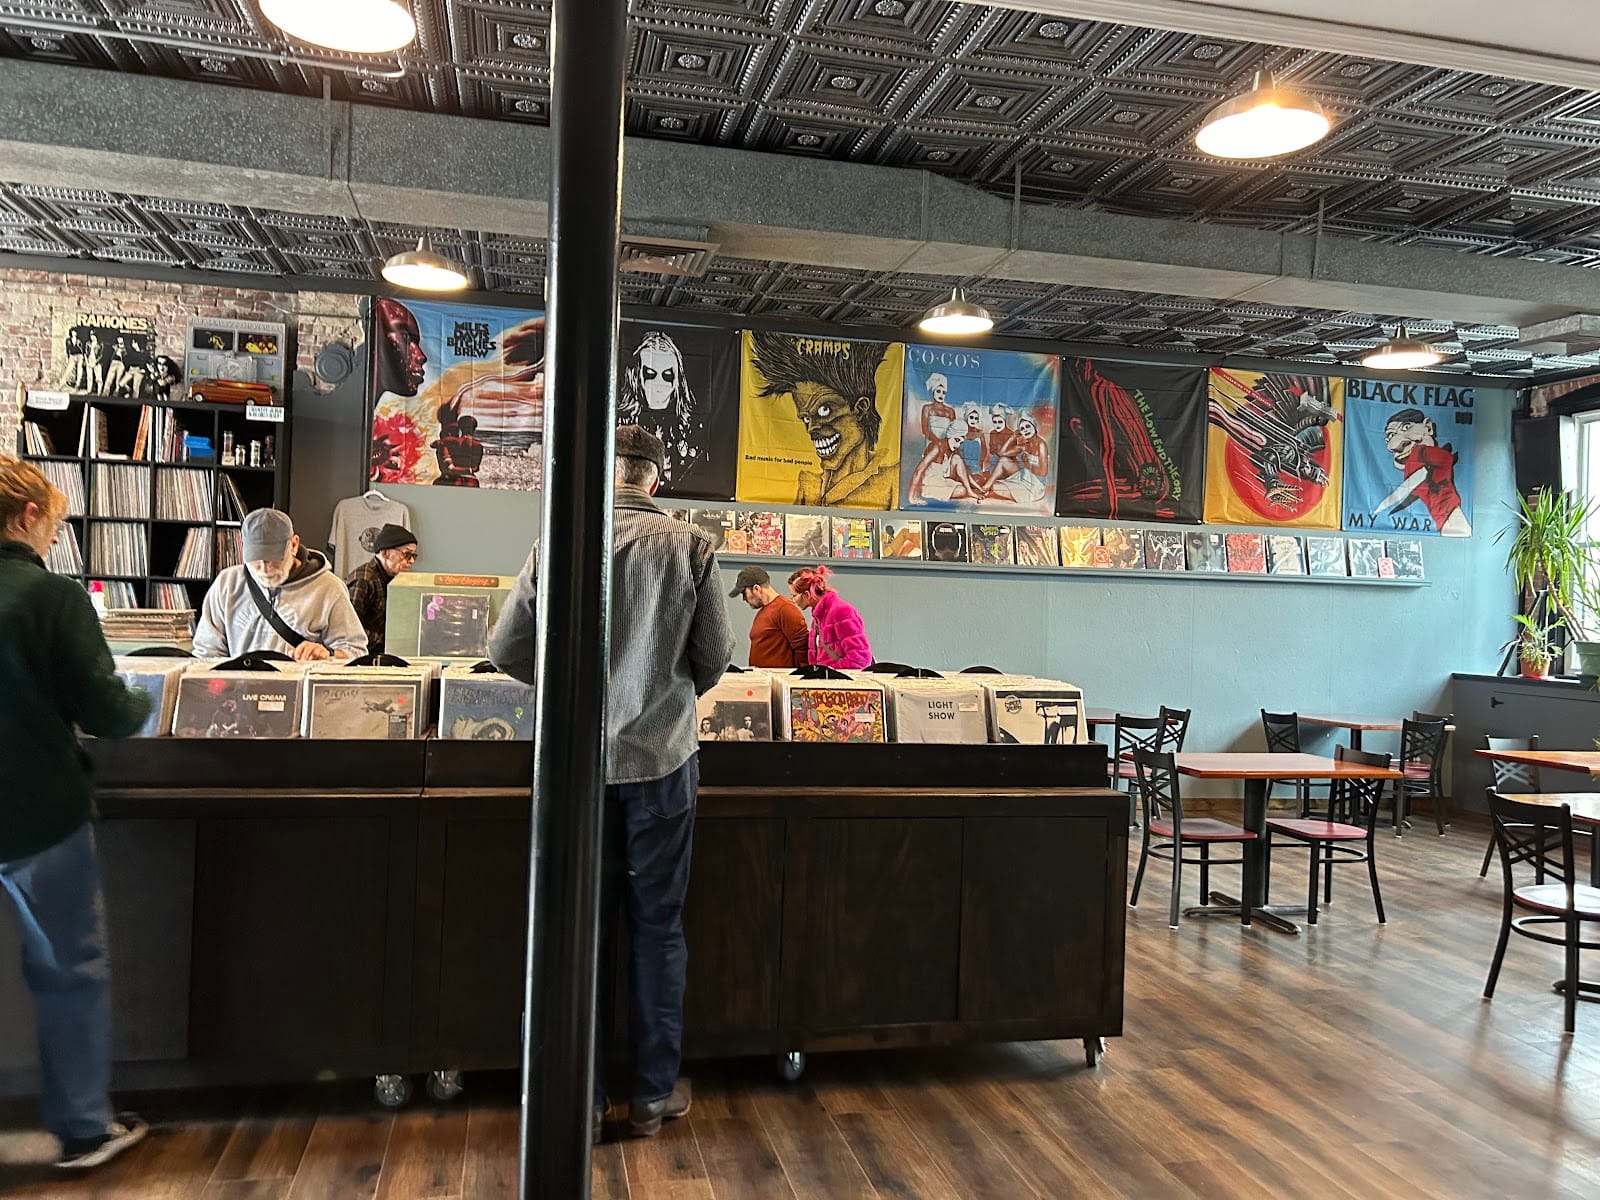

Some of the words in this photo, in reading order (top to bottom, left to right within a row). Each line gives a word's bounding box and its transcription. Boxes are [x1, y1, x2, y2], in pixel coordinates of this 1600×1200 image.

[77, 313, 148, 331] RAMONES
[454, 321, 489, 333] MILES
[454, 330, 490, 343] DAVIS
[447, 337, 496, 350] BITCHES
[796, 338, 850, 360] CRAMPS
[454, 346, 489, 358] BREW
[1347, 379, 1418, 405] BLACK
[1423, 386, 1474, 407] FLAG
[1134, 389, 1151, 413] THE
[1145, 412, 1158, 437] LOW
[1153, 439, 1167, 460] END
[1163, 457, 1182, 501] THEORY
[1348, 512, 1378, 528] MY
[1391, 516, 1432, 531] WAR
[259, 694, 287, 702] CREAM
[928, 701, 953, 709] LIGHT
[928, 712, 955, 720] SHOW
